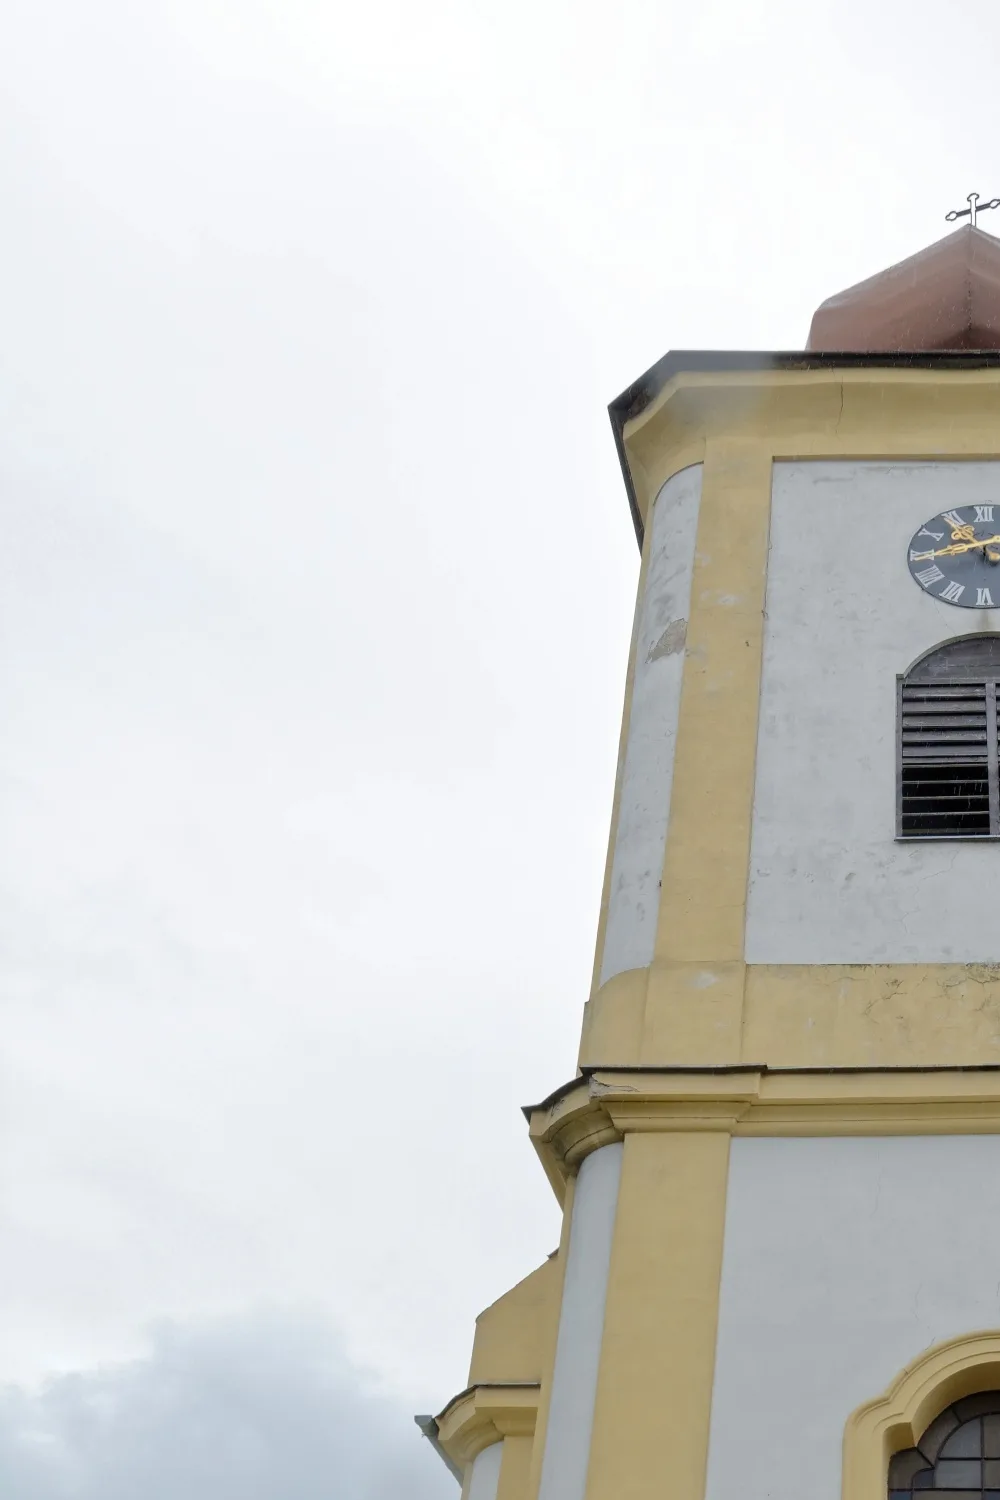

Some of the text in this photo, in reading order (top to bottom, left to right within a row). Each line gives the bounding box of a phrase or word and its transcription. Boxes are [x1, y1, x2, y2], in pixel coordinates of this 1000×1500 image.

[974, 506, 994, 523] XII
[917, 528, 945, 541] X
[976, 588, 994, 606] VI
